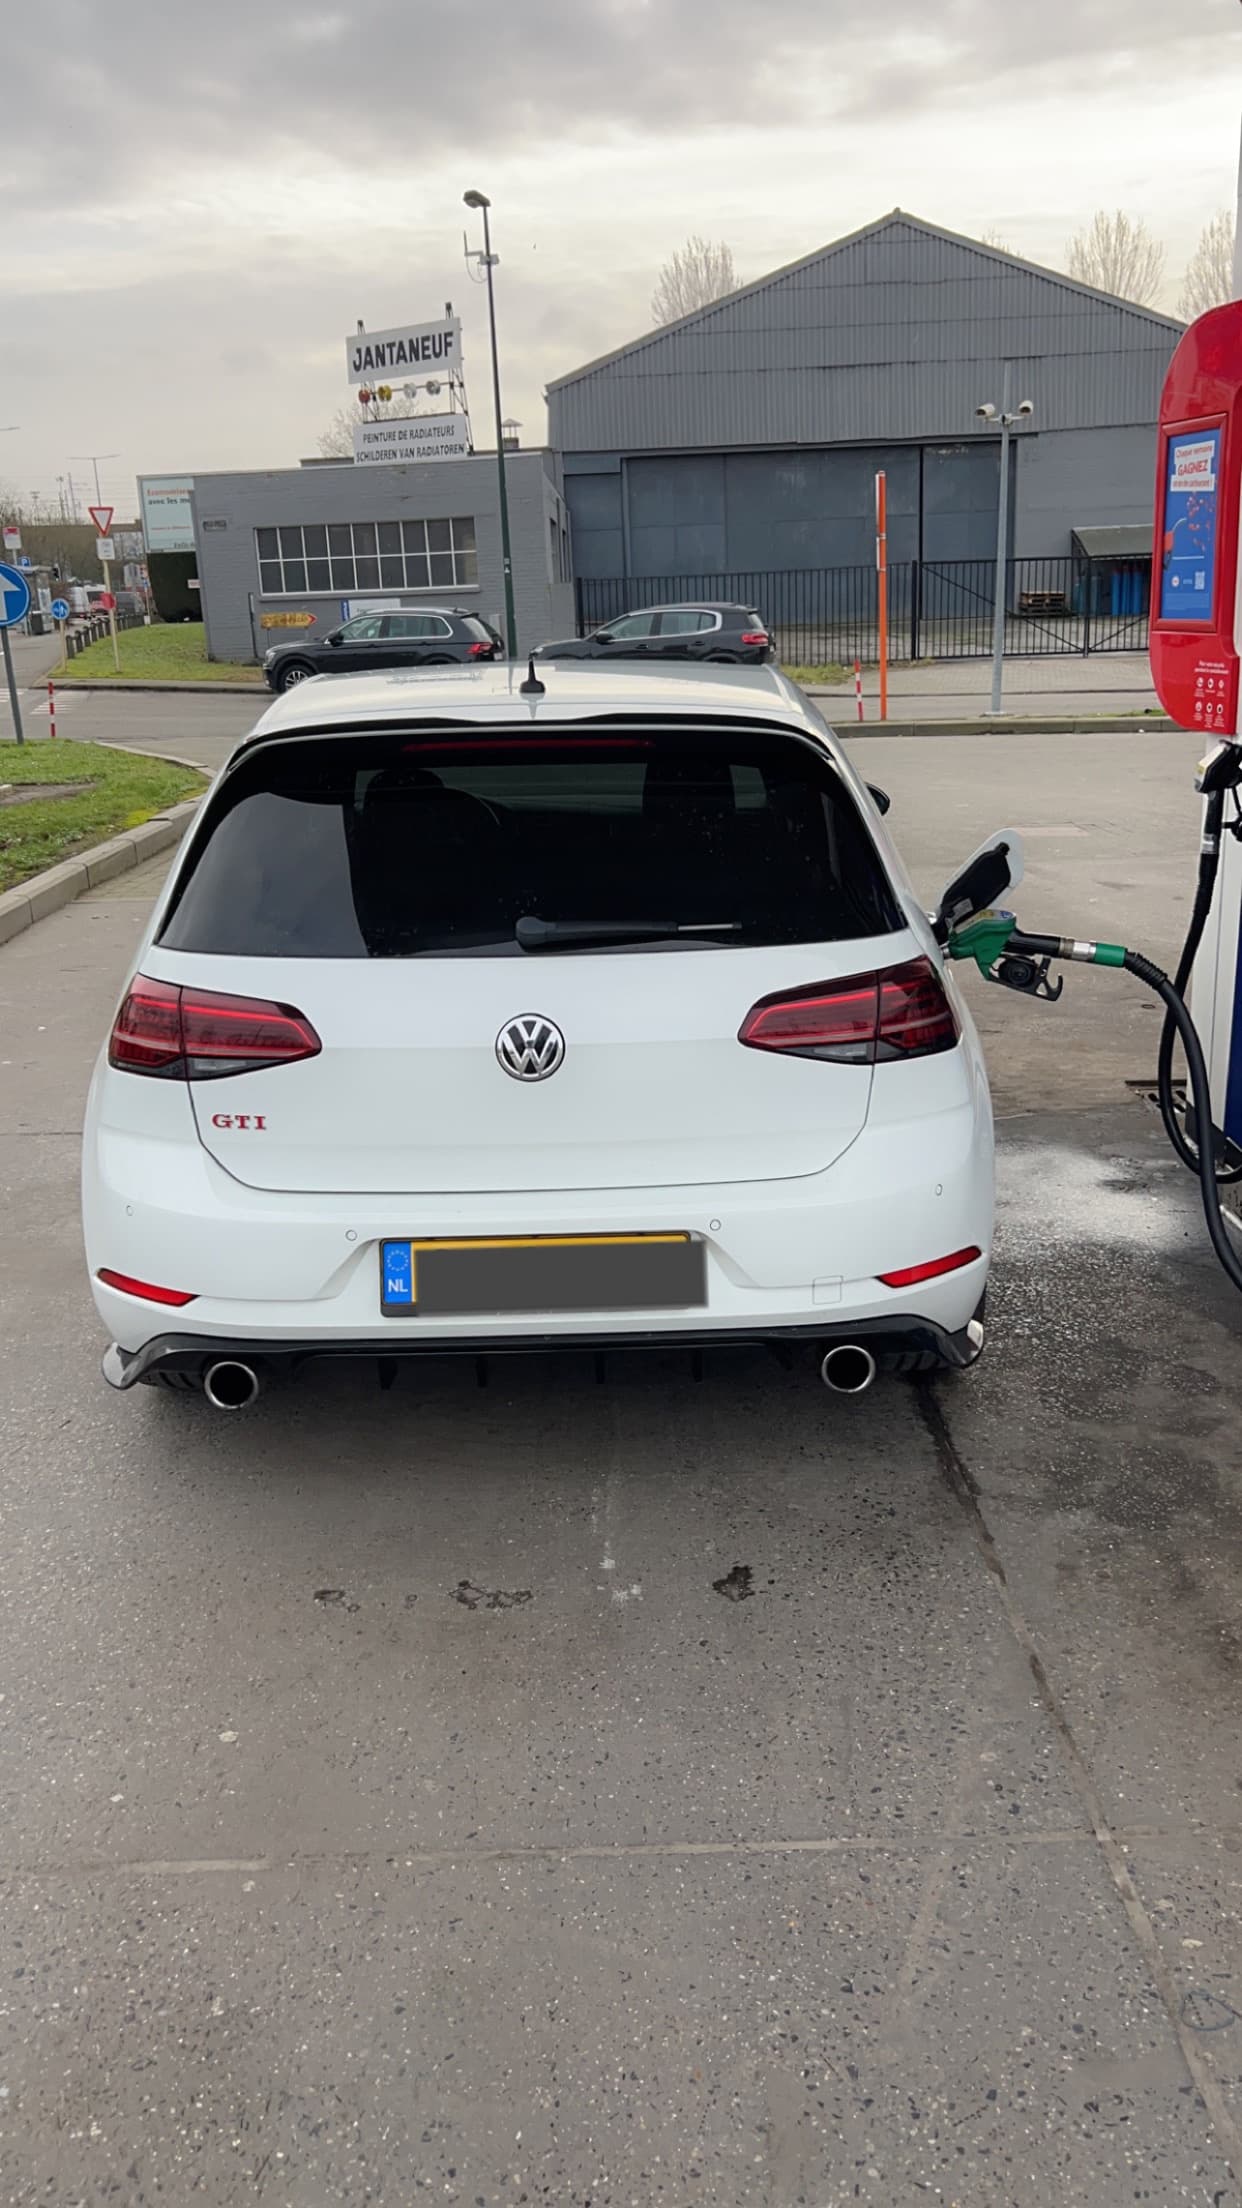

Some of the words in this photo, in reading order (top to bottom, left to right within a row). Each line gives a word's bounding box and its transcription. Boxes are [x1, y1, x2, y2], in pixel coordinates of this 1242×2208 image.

[353, 331, 454, 372] JANTANEUF
[363, 430, 397, 444] PEINTURE
[398, 429, 409, 441] DE
[410, 424, 455, 439] RADIATEURS
[356, 449, 398, 463] SCHILDEREN
[399, 447, 415, 459] VAN
[416, 442, 465, 457] RADIATOREN
[1178, 459, 1208, 476] GAGNEZ
[212, 1113, 267, 1131] GTI
[387, 1278, 409, 1294] NL
